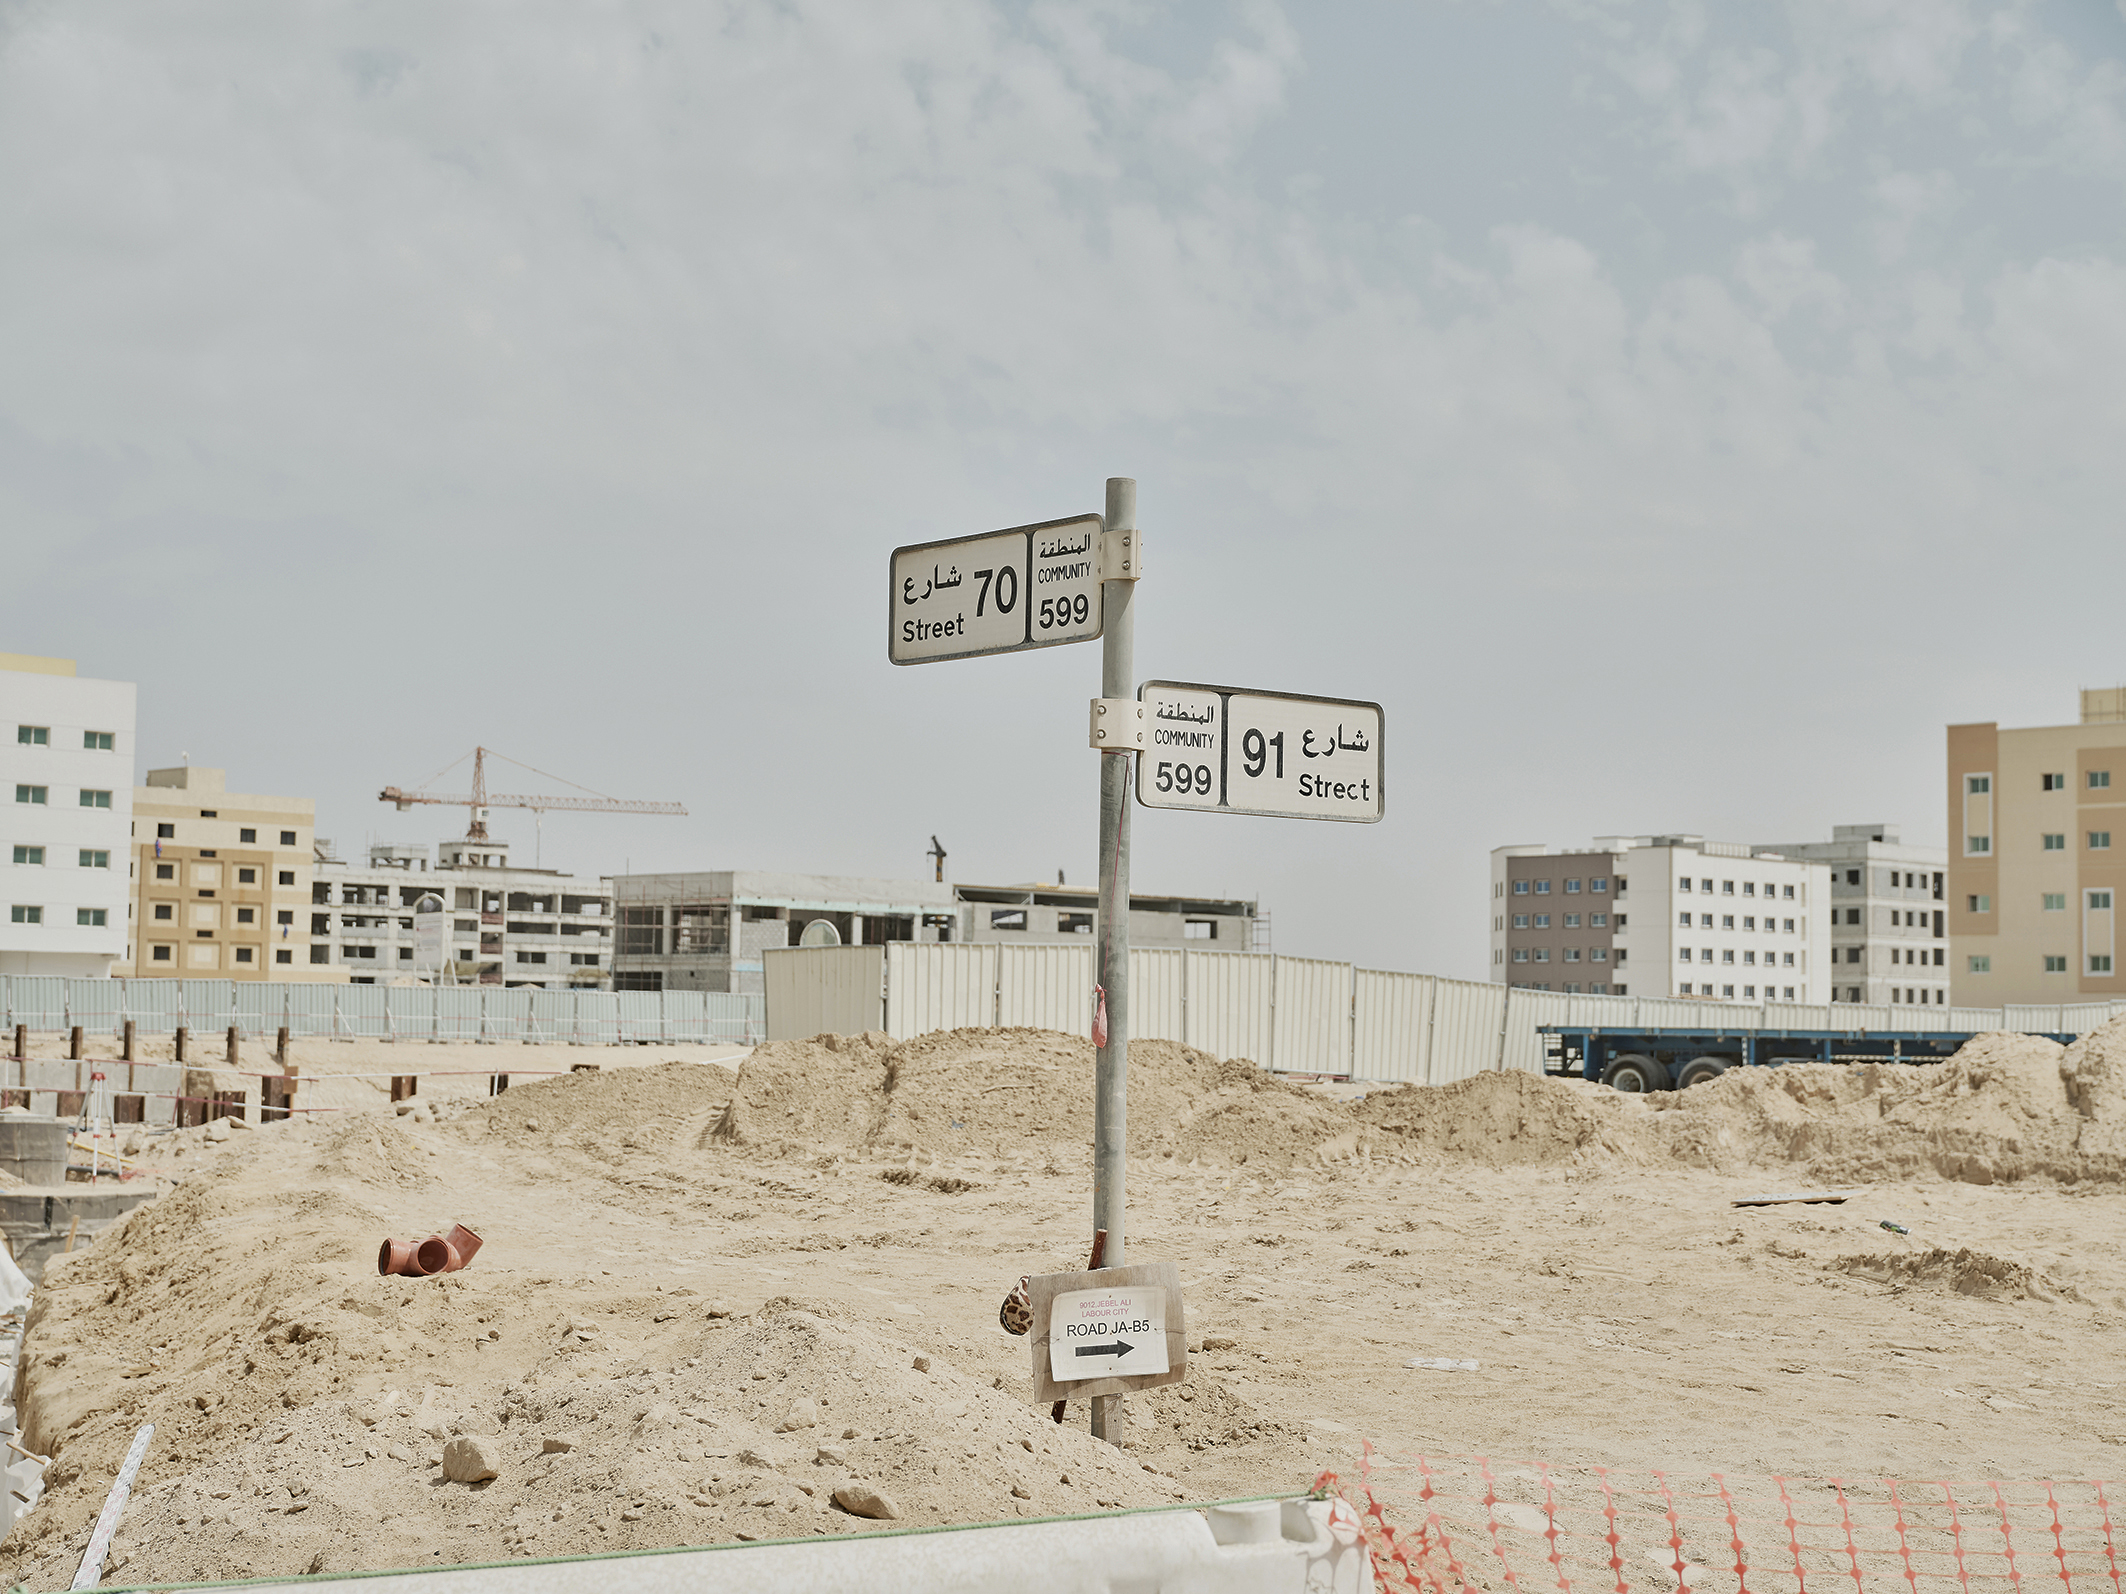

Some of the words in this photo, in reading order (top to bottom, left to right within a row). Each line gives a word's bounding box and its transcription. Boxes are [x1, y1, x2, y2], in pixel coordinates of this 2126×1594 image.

[1040, 534, 1091, 558] المنطقة
[1038, 562, 1091, 584] COMMUNITY
[903, 564, 962, 605] شارع
[973, 565, 1018, 617] 70
[1039, 594, 1089, 629] 599
[902, 612, 964, 642] Street
[1156, 702, 1215, 725] المنطقة
[1155, 729, 1215, 749] COMMUNITY
[1242, 728, 1284, 778] 91
[1302, 723, 1370, 758] شارع
[1155, 762, 1212, 796] 599
[1067, 1322, 1107, 1336] ROAD
[1111, 1320, 1150, 1334] JA-B5
